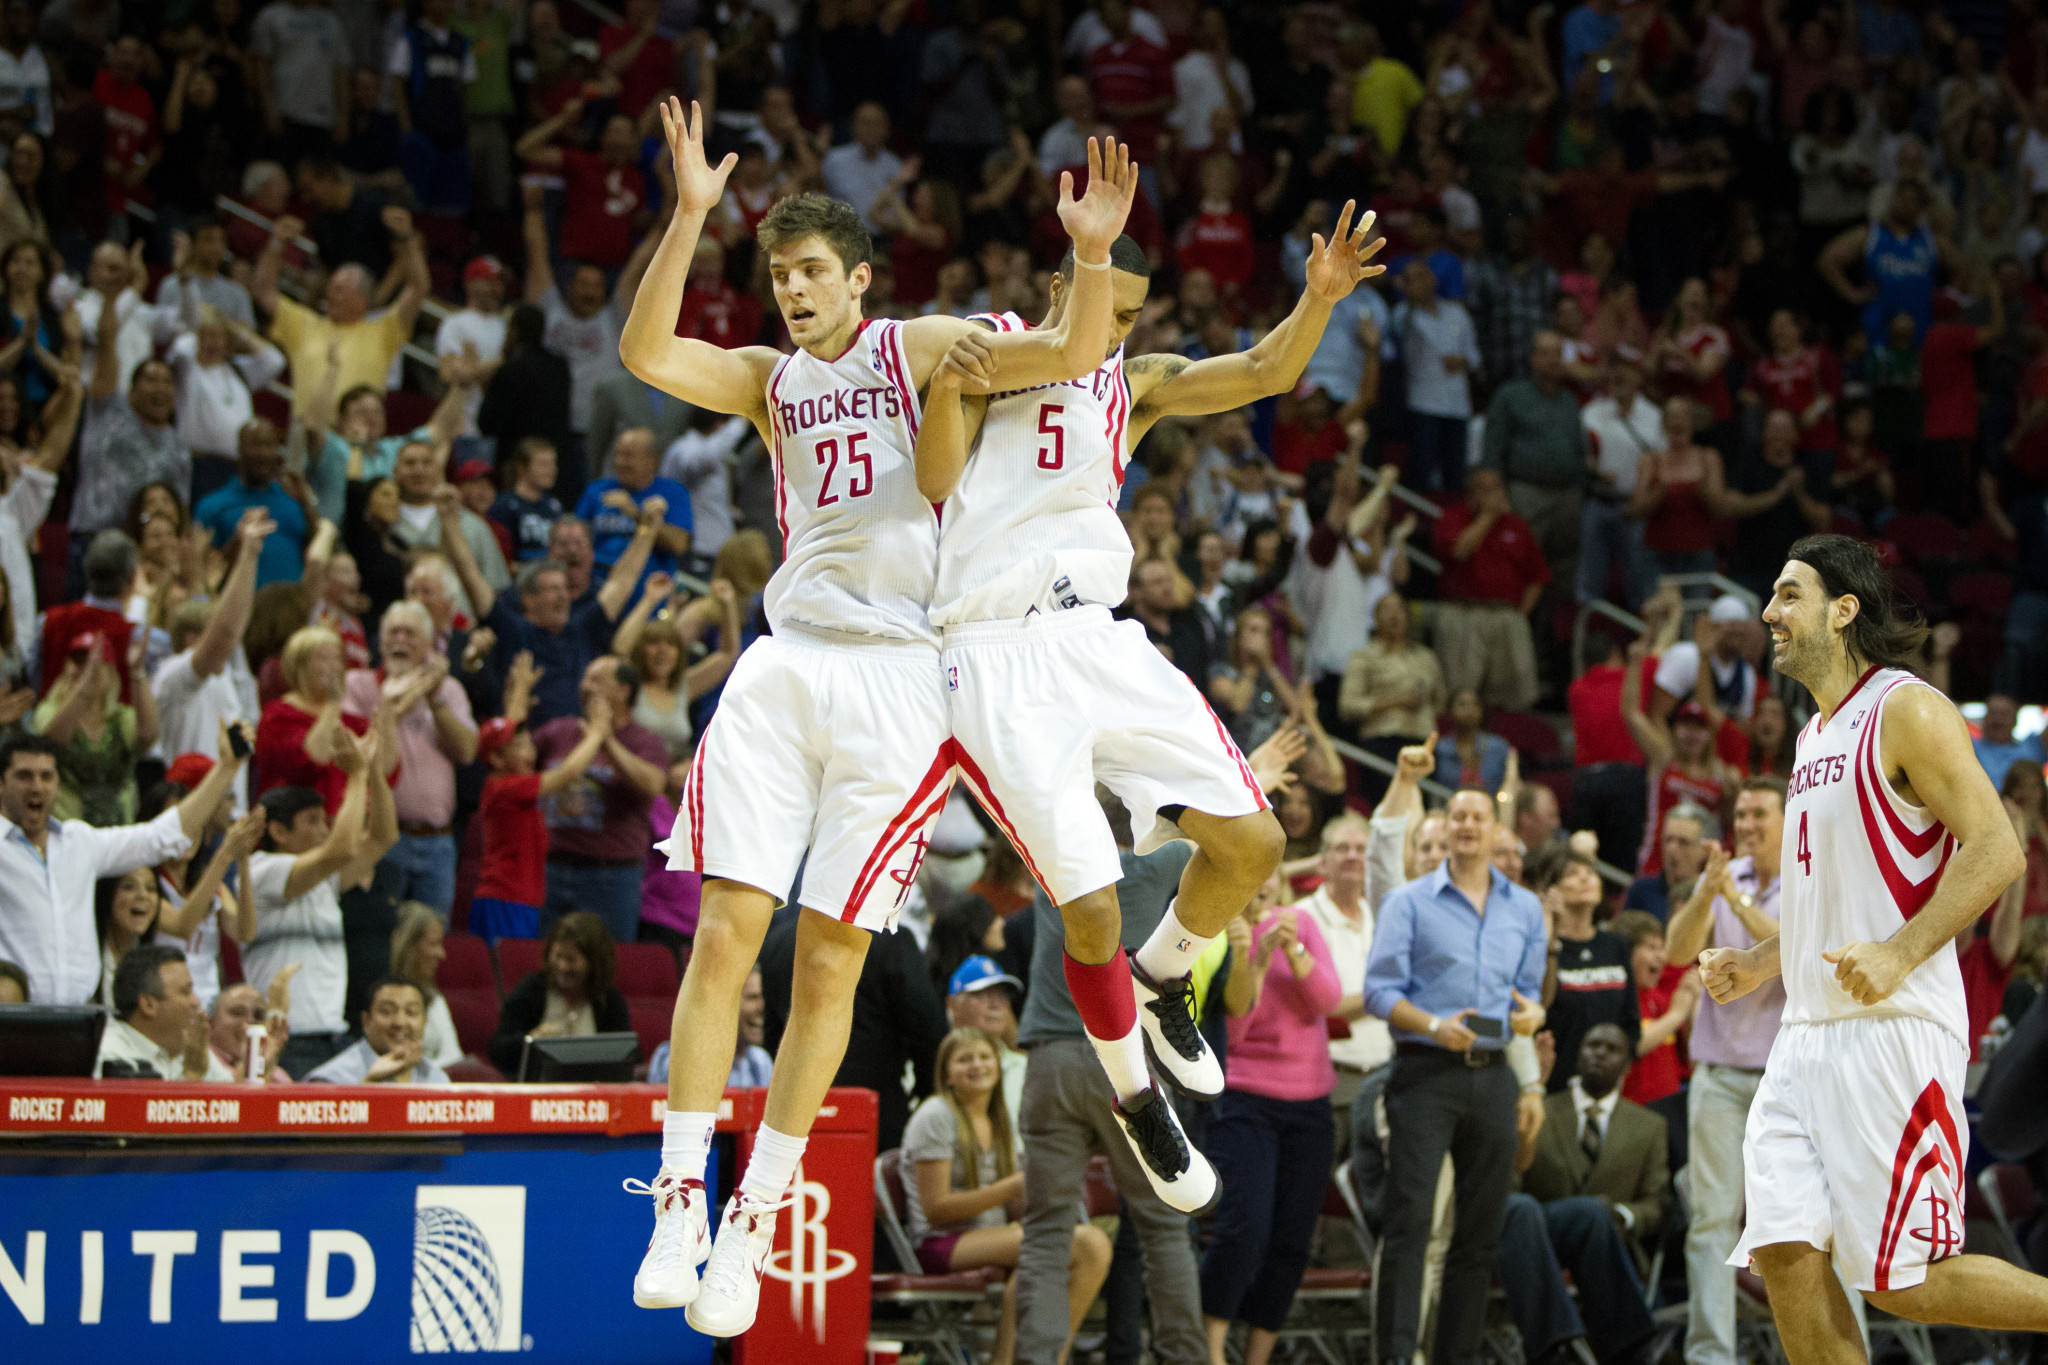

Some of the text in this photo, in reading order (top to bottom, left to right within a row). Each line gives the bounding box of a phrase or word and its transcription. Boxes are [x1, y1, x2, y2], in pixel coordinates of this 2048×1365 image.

[778, 386, 900, 438] ROCKETS
[1037, 402, 1064, 470] 5
[814, 431, 873, 508] 25
[1797, 810, 1812, 877] 4
[146, 1099, 241, 1123] ROCKETS.COM
[279, 1100, 370, 1124] ROCKETS.COM
[407, 1099, 495, 1123] ROCKETS.COM
